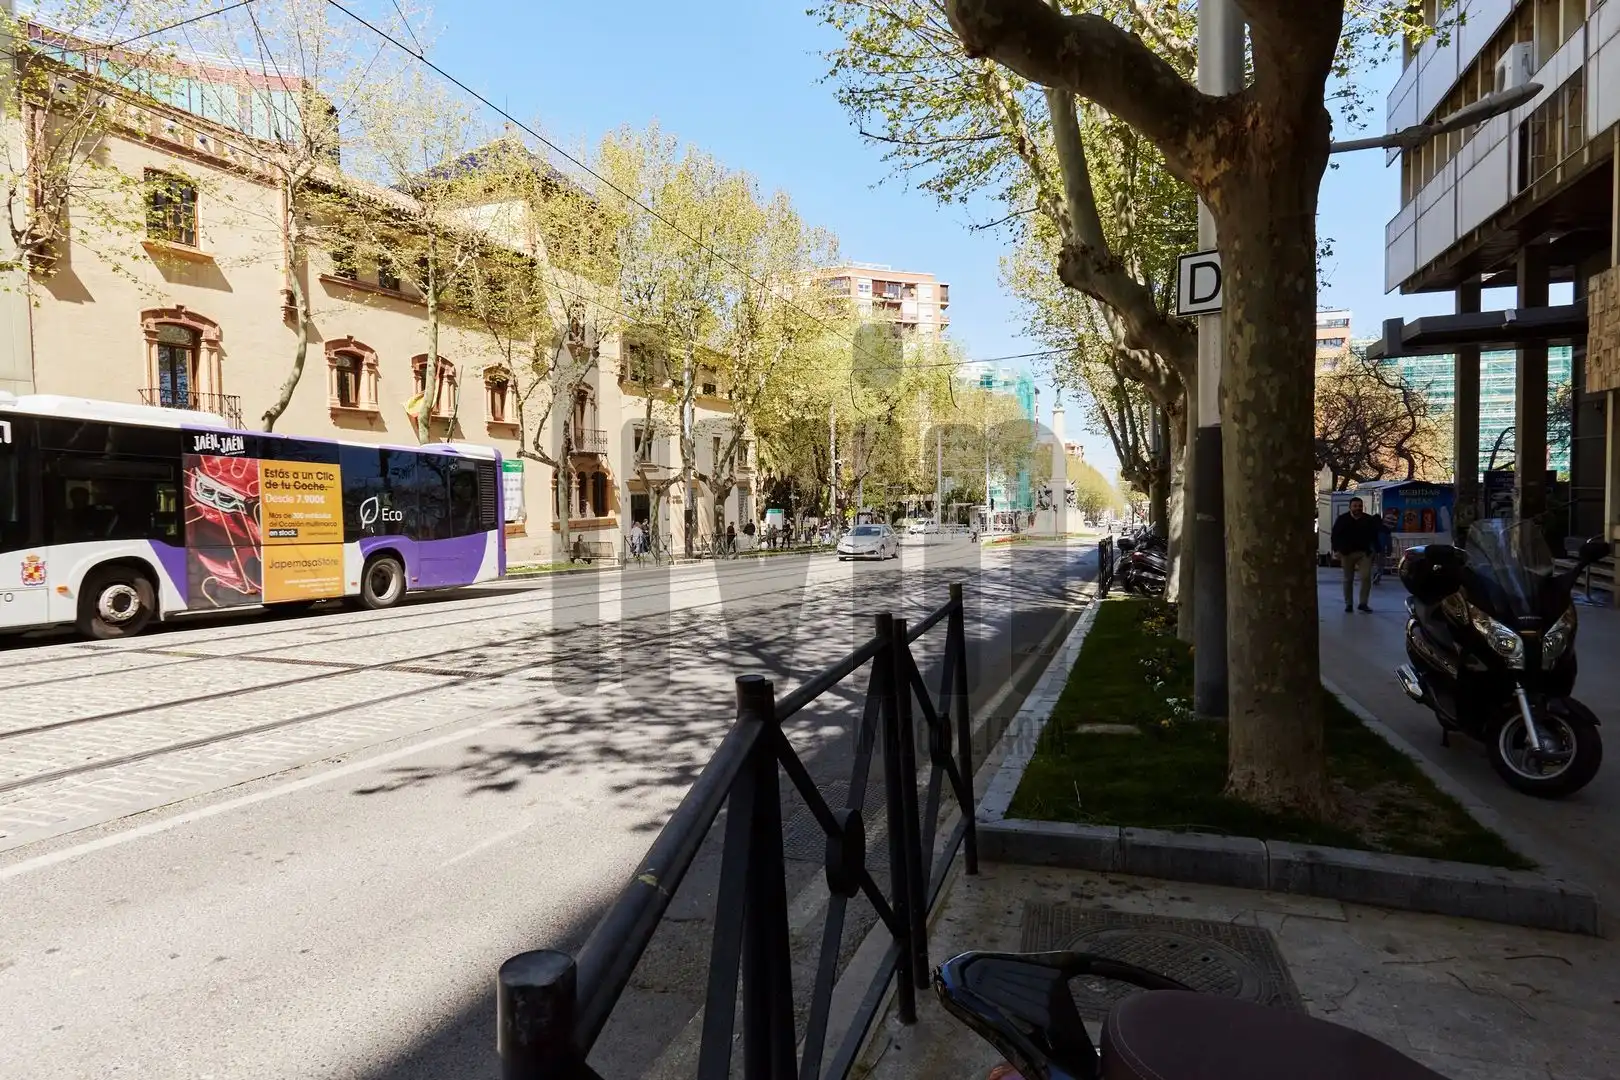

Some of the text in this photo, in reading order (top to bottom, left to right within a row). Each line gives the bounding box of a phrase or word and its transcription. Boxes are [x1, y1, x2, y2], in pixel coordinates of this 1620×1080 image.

[1190, 261, 1222, 304] D
[220, 435, 244, 453] JAÉN
[264, 468, 335, 481] Estás a un Clic
[264, 480, 278, 489] de
[280, 480, 291, 490] tu
[382, 508, 403, 522] Eco
